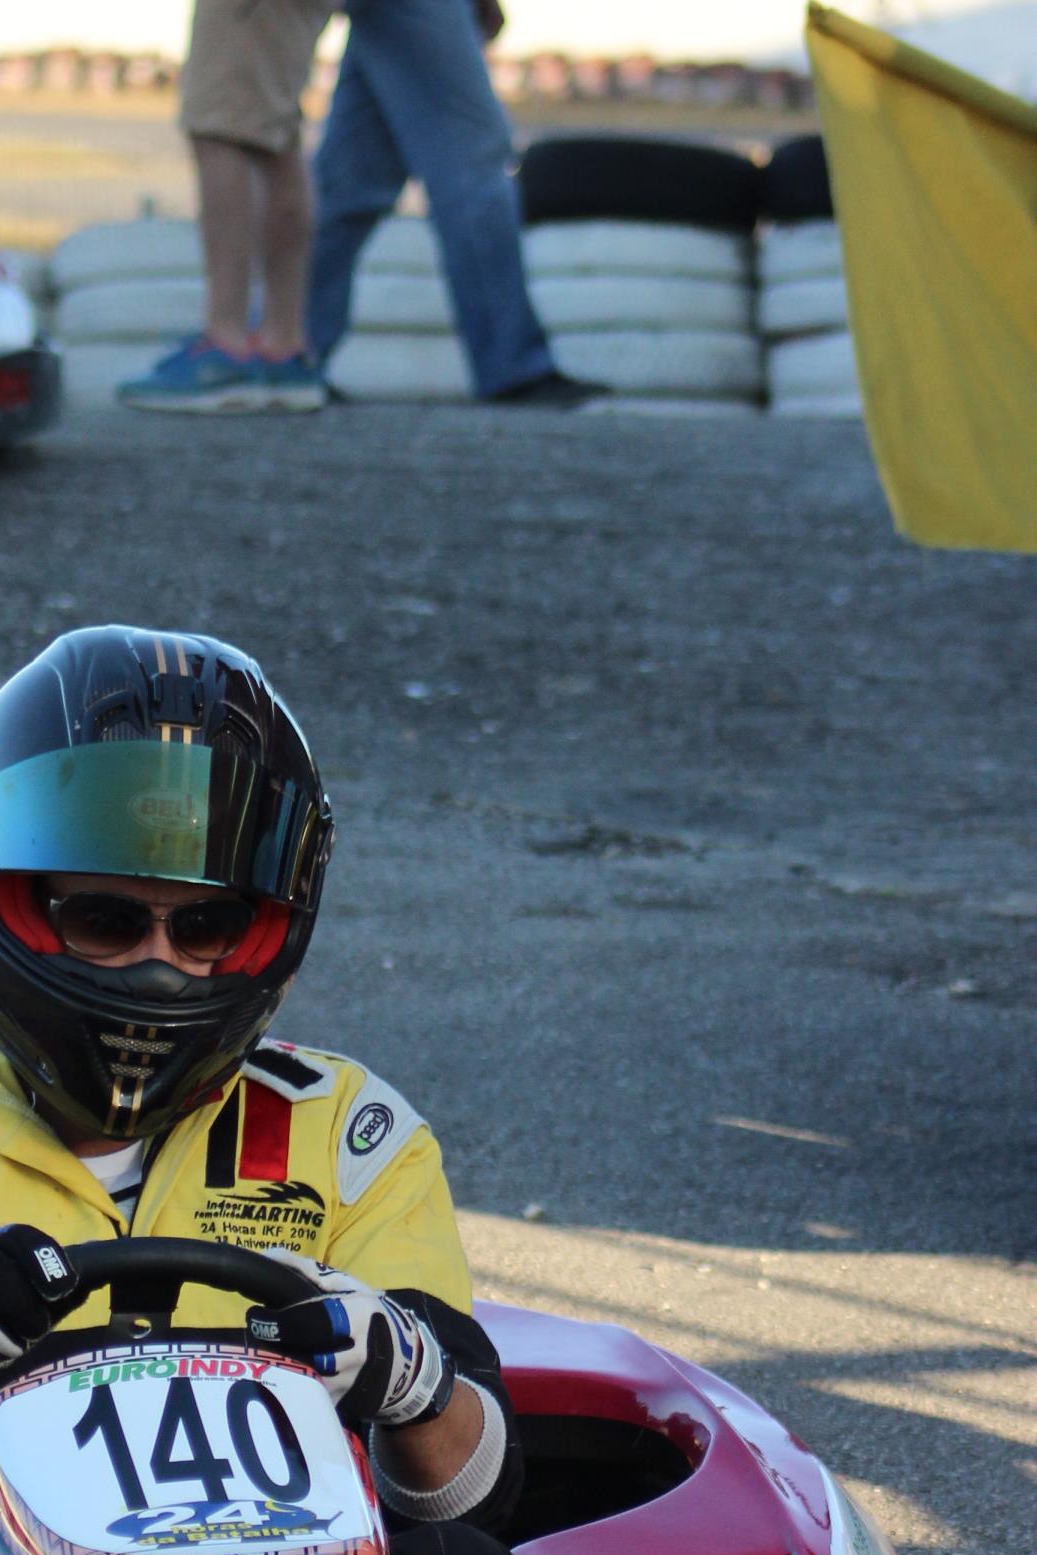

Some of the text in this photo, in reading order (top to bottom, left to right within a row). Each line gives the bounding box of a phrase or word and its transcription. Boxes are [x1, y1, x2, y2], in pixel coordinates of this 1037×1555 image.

[241, 1204, 325, 1228] KARTING
[200, 1222, 216, 1234] 24
[223, 1221, 256, 1236] Horas
[290, 1227, 317, 1241] 2010
[38, 1247, 64, 1279] OMP
[250, 1323, 280, 1339] OMP
[71, 1376, 312, 1512] 140
[137, 1501, 270, 1534] 24
[186, 1526, 310, 1543] Batalha
